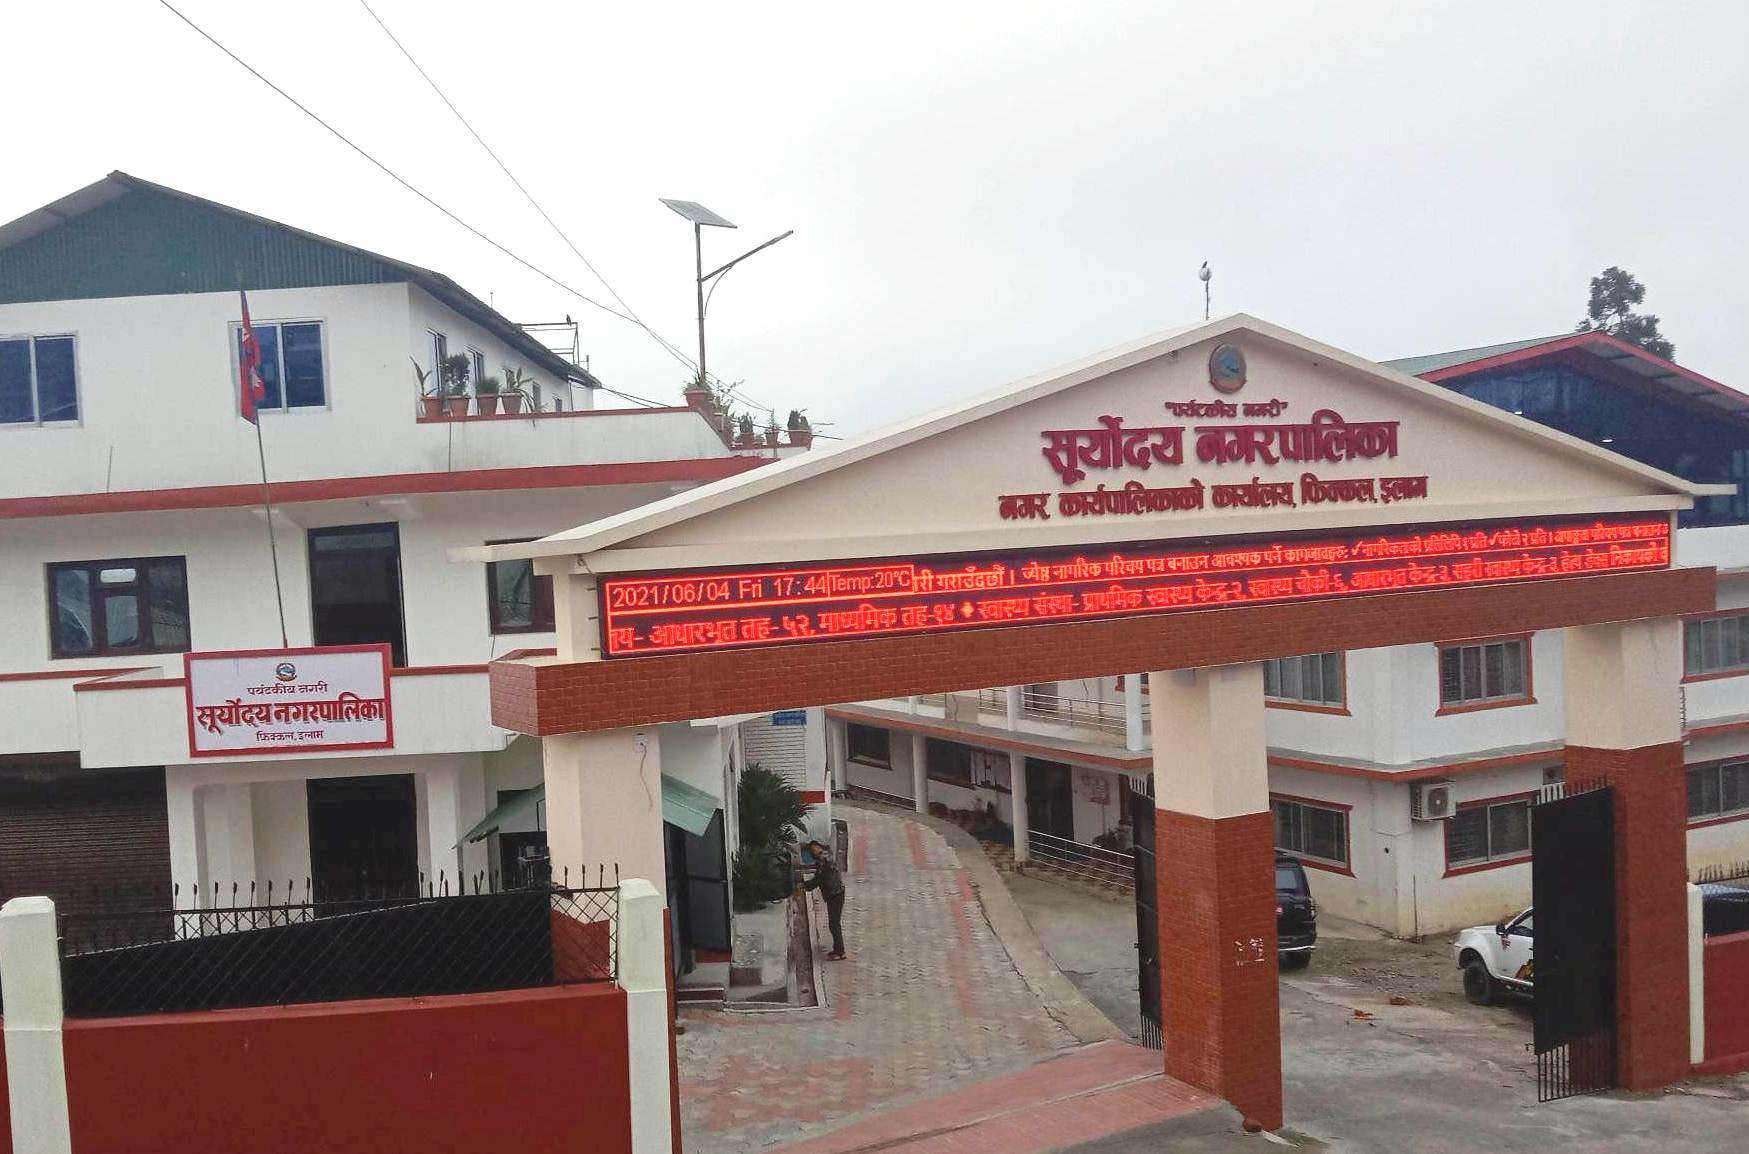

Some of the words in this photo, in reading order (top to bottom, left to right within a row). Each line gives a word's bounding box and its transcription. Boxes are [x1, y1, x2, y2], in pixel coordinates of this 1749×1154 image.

[1041, 415, 1186, 485] सूर्योदय
[1194, 409, 1400, 464] नगरपालिका
[999, 493, 1051, 520] नगर
[1058, 478, 1205, 517] कार्यपालिकाको
[1379, 476, 1429, 504] इलाम
[1053, 557, 1101, 580] नागरिक
[612, 582, 730, 607] 2021/06/04
[739, 580, 762, 599] Fri
[774, 575, 826, 596] 17:44
[195, 697, 272, 735] सूर्योदय
[274, 691, 386, 725] नगरपालिका
